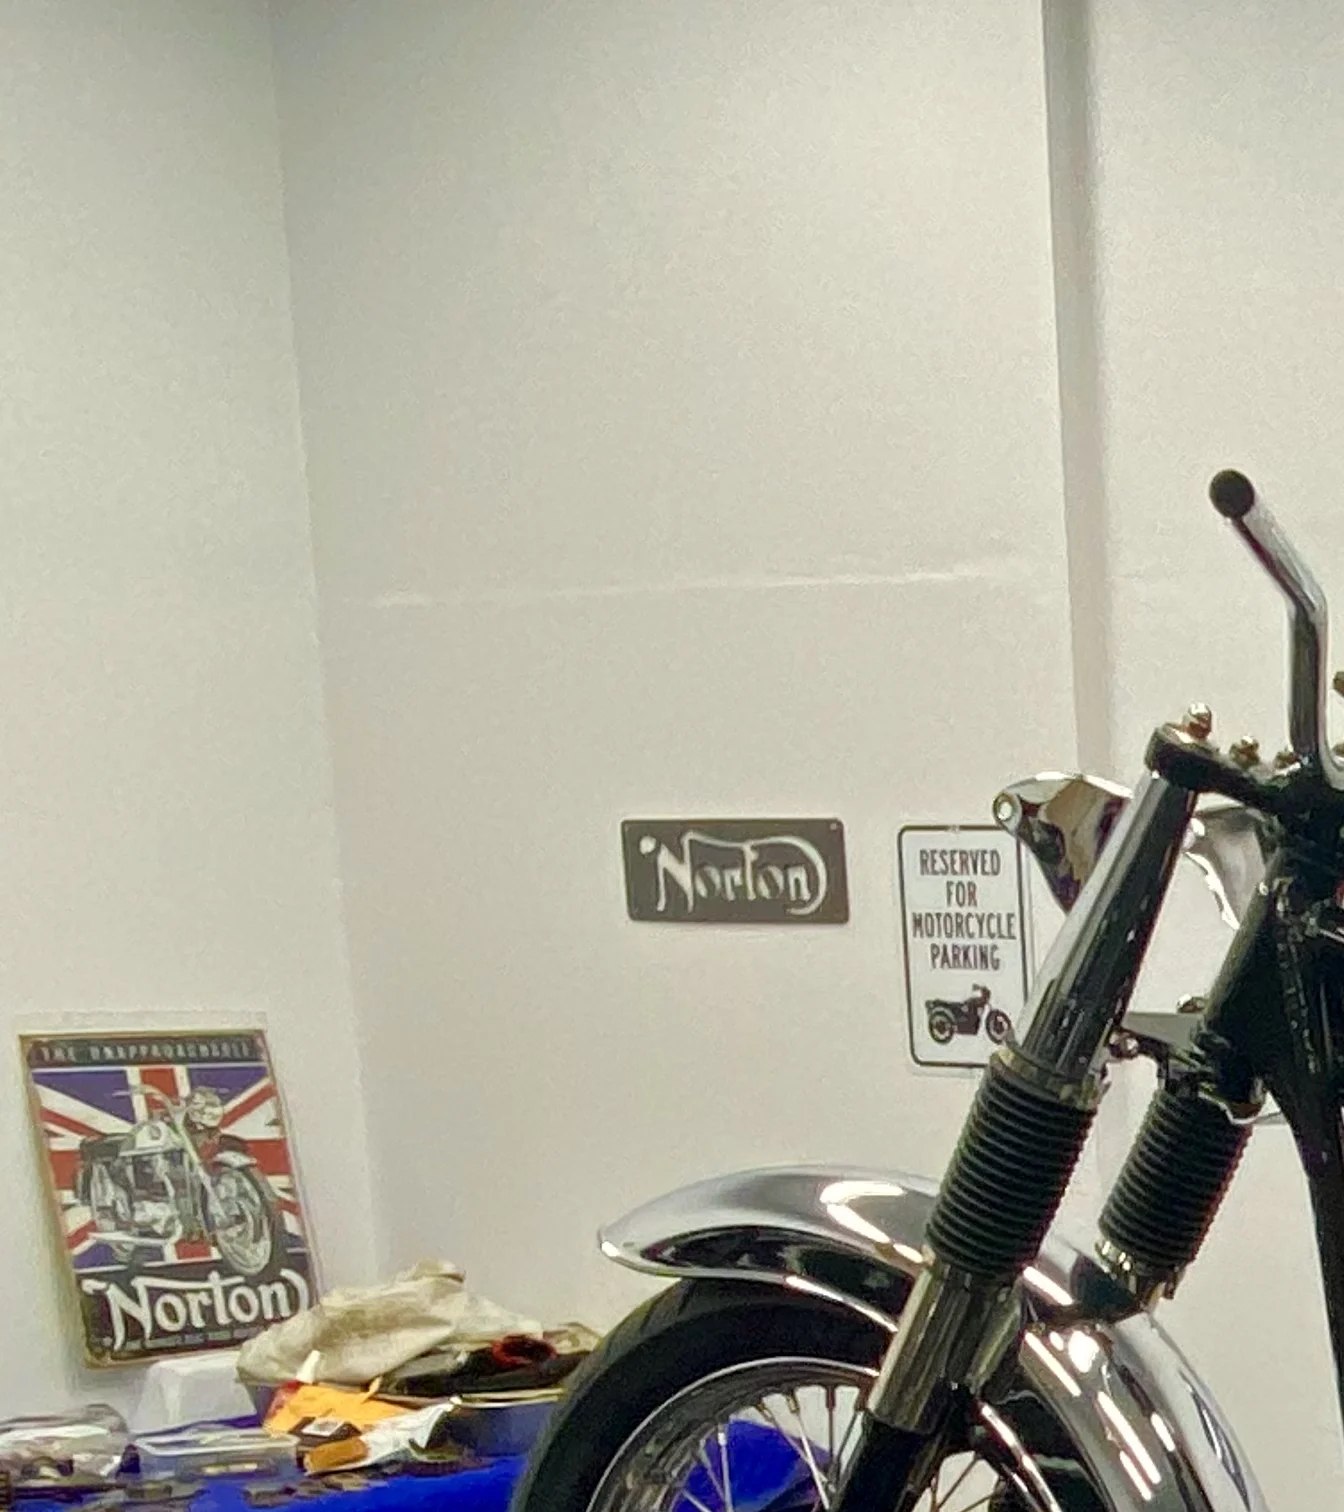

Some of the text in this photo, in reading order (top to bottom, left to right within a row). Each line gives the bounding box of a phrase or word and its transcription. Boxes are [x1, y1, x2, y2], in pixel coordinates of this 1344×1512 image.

[639, 830, 827, 915] Norton
[919, 848, 1001, 876] RESERVED
[946, 880, 978, 907] FOR
[912, 912, 1016, 940] MOTORCYCLE
[930, 943, 1001, 970] PARKING
[81, 1268, 308, 1351] Norton
